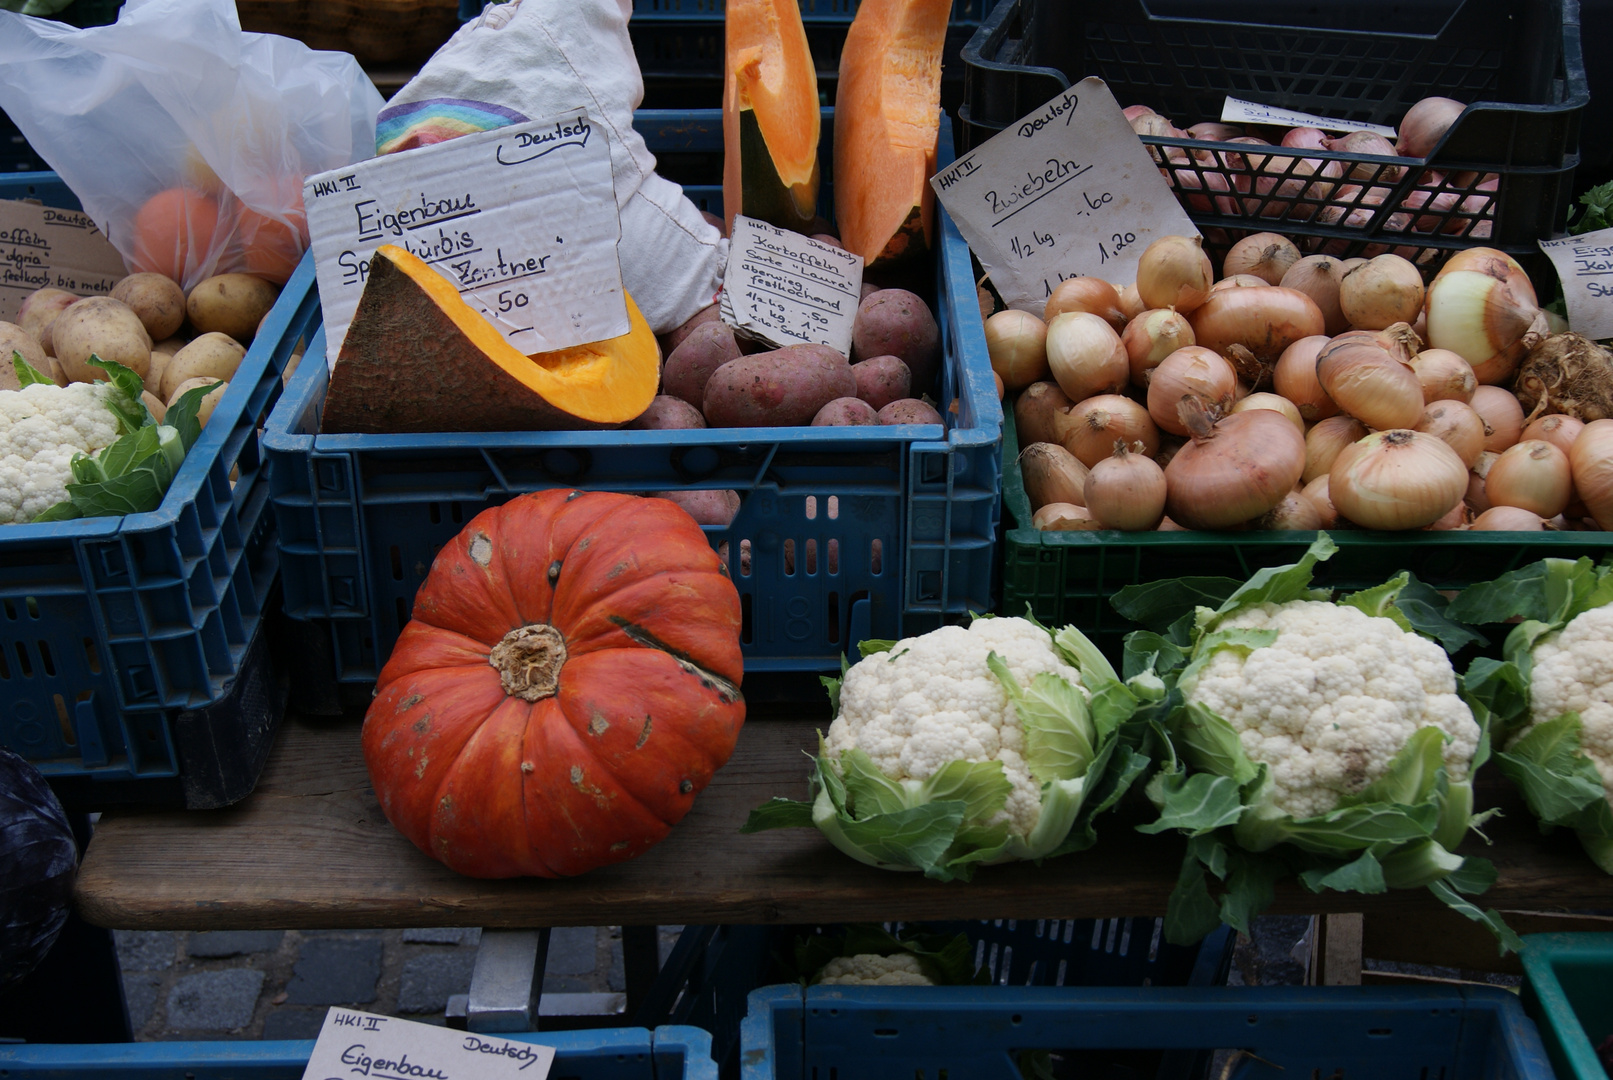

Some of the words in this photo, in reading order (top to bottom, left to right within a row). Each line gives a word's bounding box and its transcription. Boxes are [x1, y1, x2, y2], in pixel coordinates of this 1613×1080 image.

[515, 117, 591, 147] Deutsch
[984, 158, 1081, 214] Zwiebeln
[355, 193, 477, 236] Eigenbau
[746, 249, 783, 268] Sorte
[752, 234, 839, 273] Kartoffeln
[806, 239, 857, 265] Deutsch
[57, 274, 76, 289] bis
[340, 1044, 449, 1080] Eigenbau
[462, 1036, 538, 1070] Deutsch
